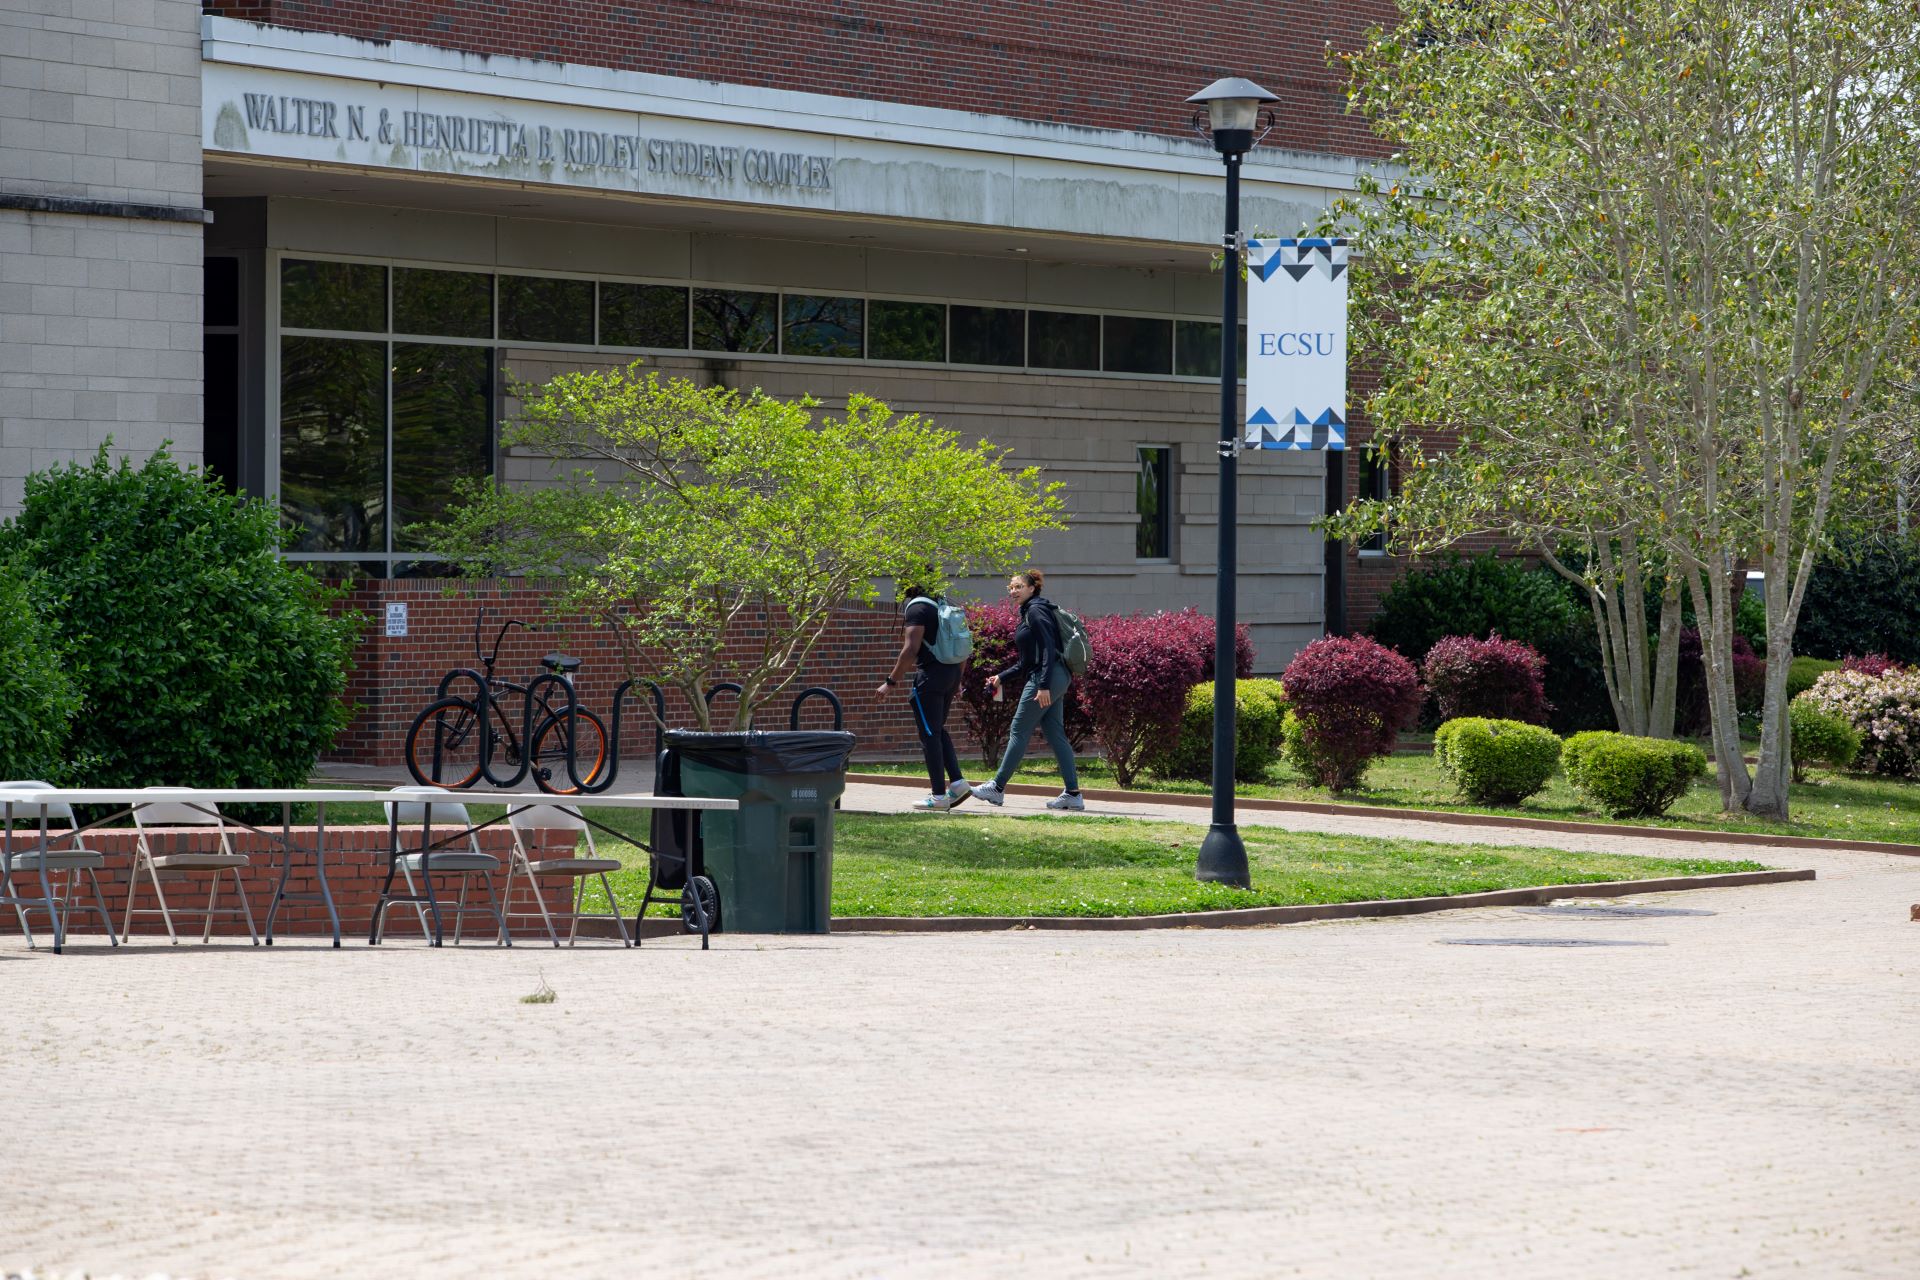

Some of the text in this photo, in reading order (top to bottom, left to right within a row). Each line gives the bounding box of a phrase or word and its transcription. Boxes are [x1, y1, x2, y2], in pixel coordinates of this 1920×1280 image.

[243, 93, 833, 189] WALTER N. & HENRIETTA B. RIDLEY STUDENT COMPLEX
[1259, 333, 1335, 356] ECSU
